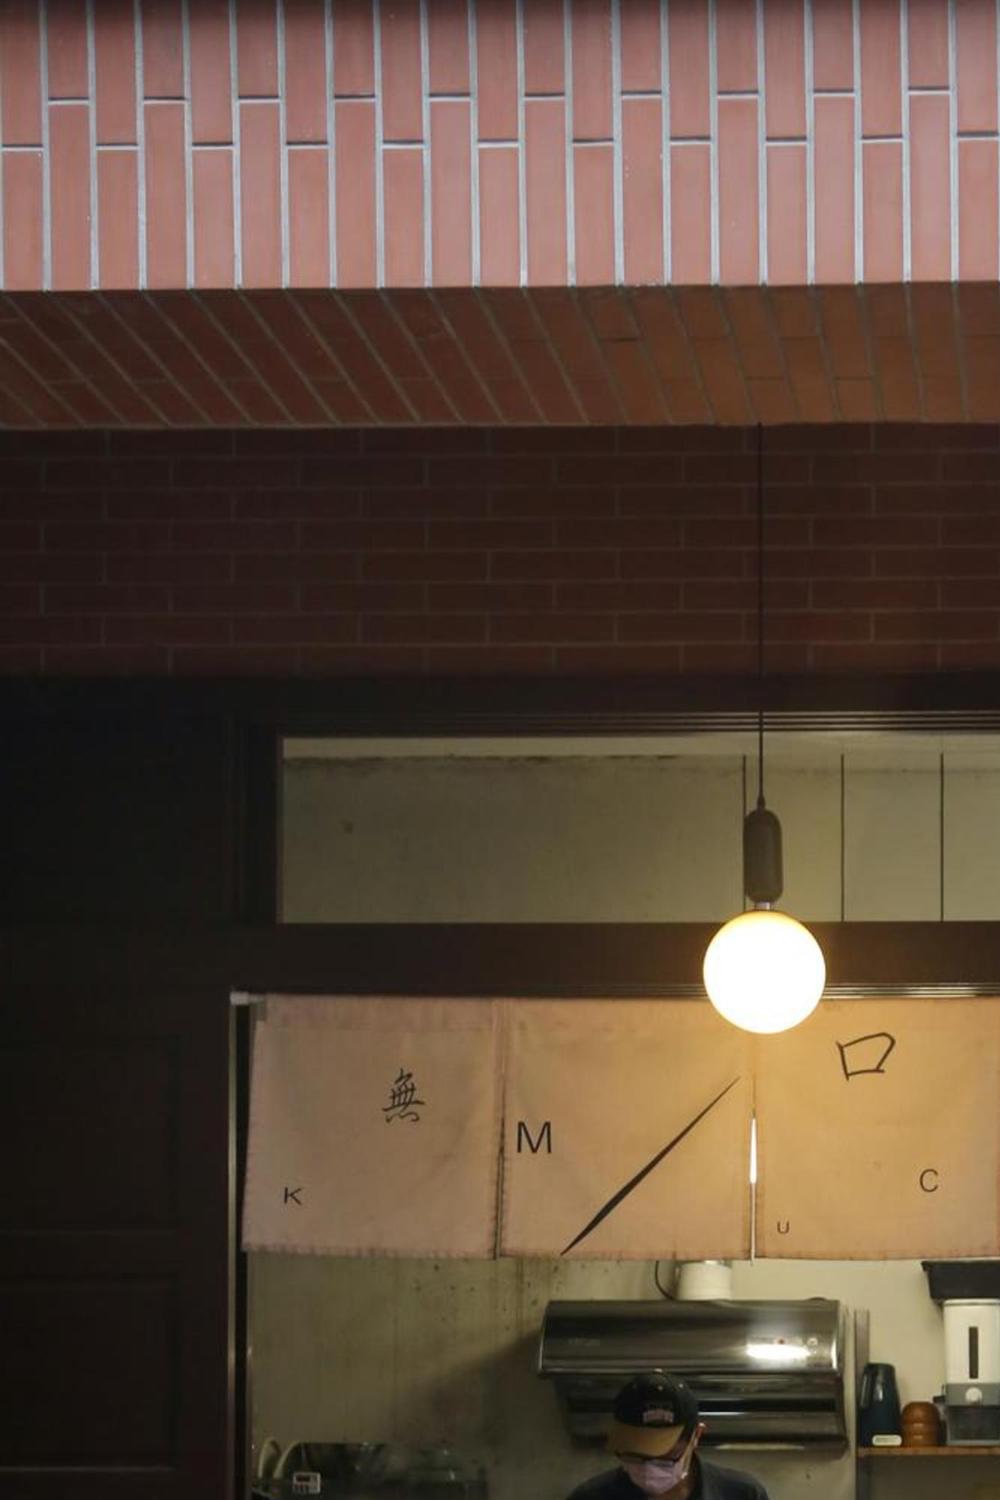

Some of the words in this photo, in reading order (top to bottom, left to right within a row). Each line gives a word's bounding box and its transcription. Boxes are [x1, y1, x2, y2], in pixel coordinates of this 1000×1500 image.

[381, 1067, 425, 1124] 無
[516, 1120, 553, 1155] M
[919, 1168, 939, 1193] C
[283, 1186, 302, 1206] K
[776, 1221, 790, 1235] U
